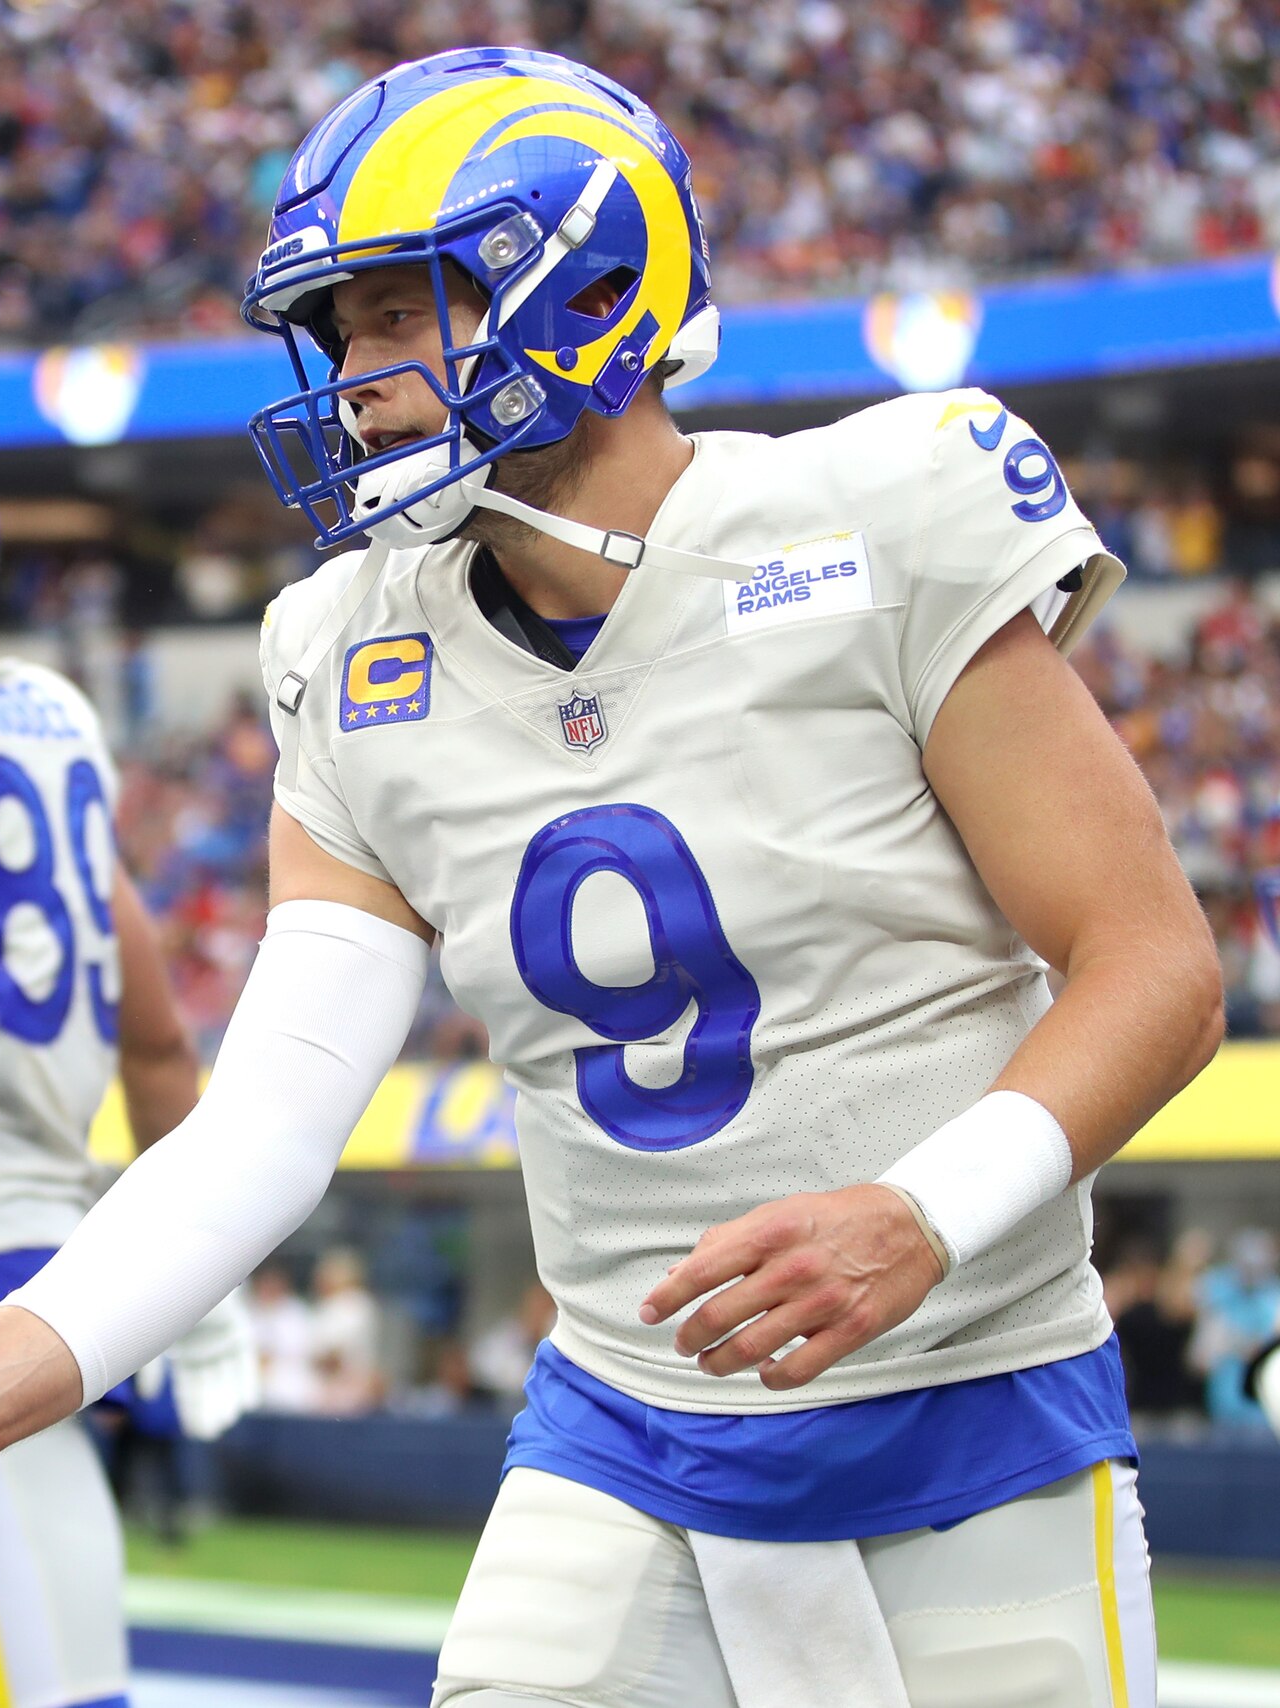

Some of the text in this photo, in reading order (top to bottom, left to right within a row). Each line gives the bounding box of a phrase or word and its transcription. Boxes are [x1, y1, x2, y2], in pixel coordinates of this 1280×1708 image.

[1003, 438, 1067, 522] 9
[736, 560, 785, 585] OS
[736, 561, 858, 600] ANGELES
[737, 585, 812, 616] RAMS
[346, 639, 426, 705] C
[566, 716, 601, 743] NFL
[510, 803, 762, 1152] 9
